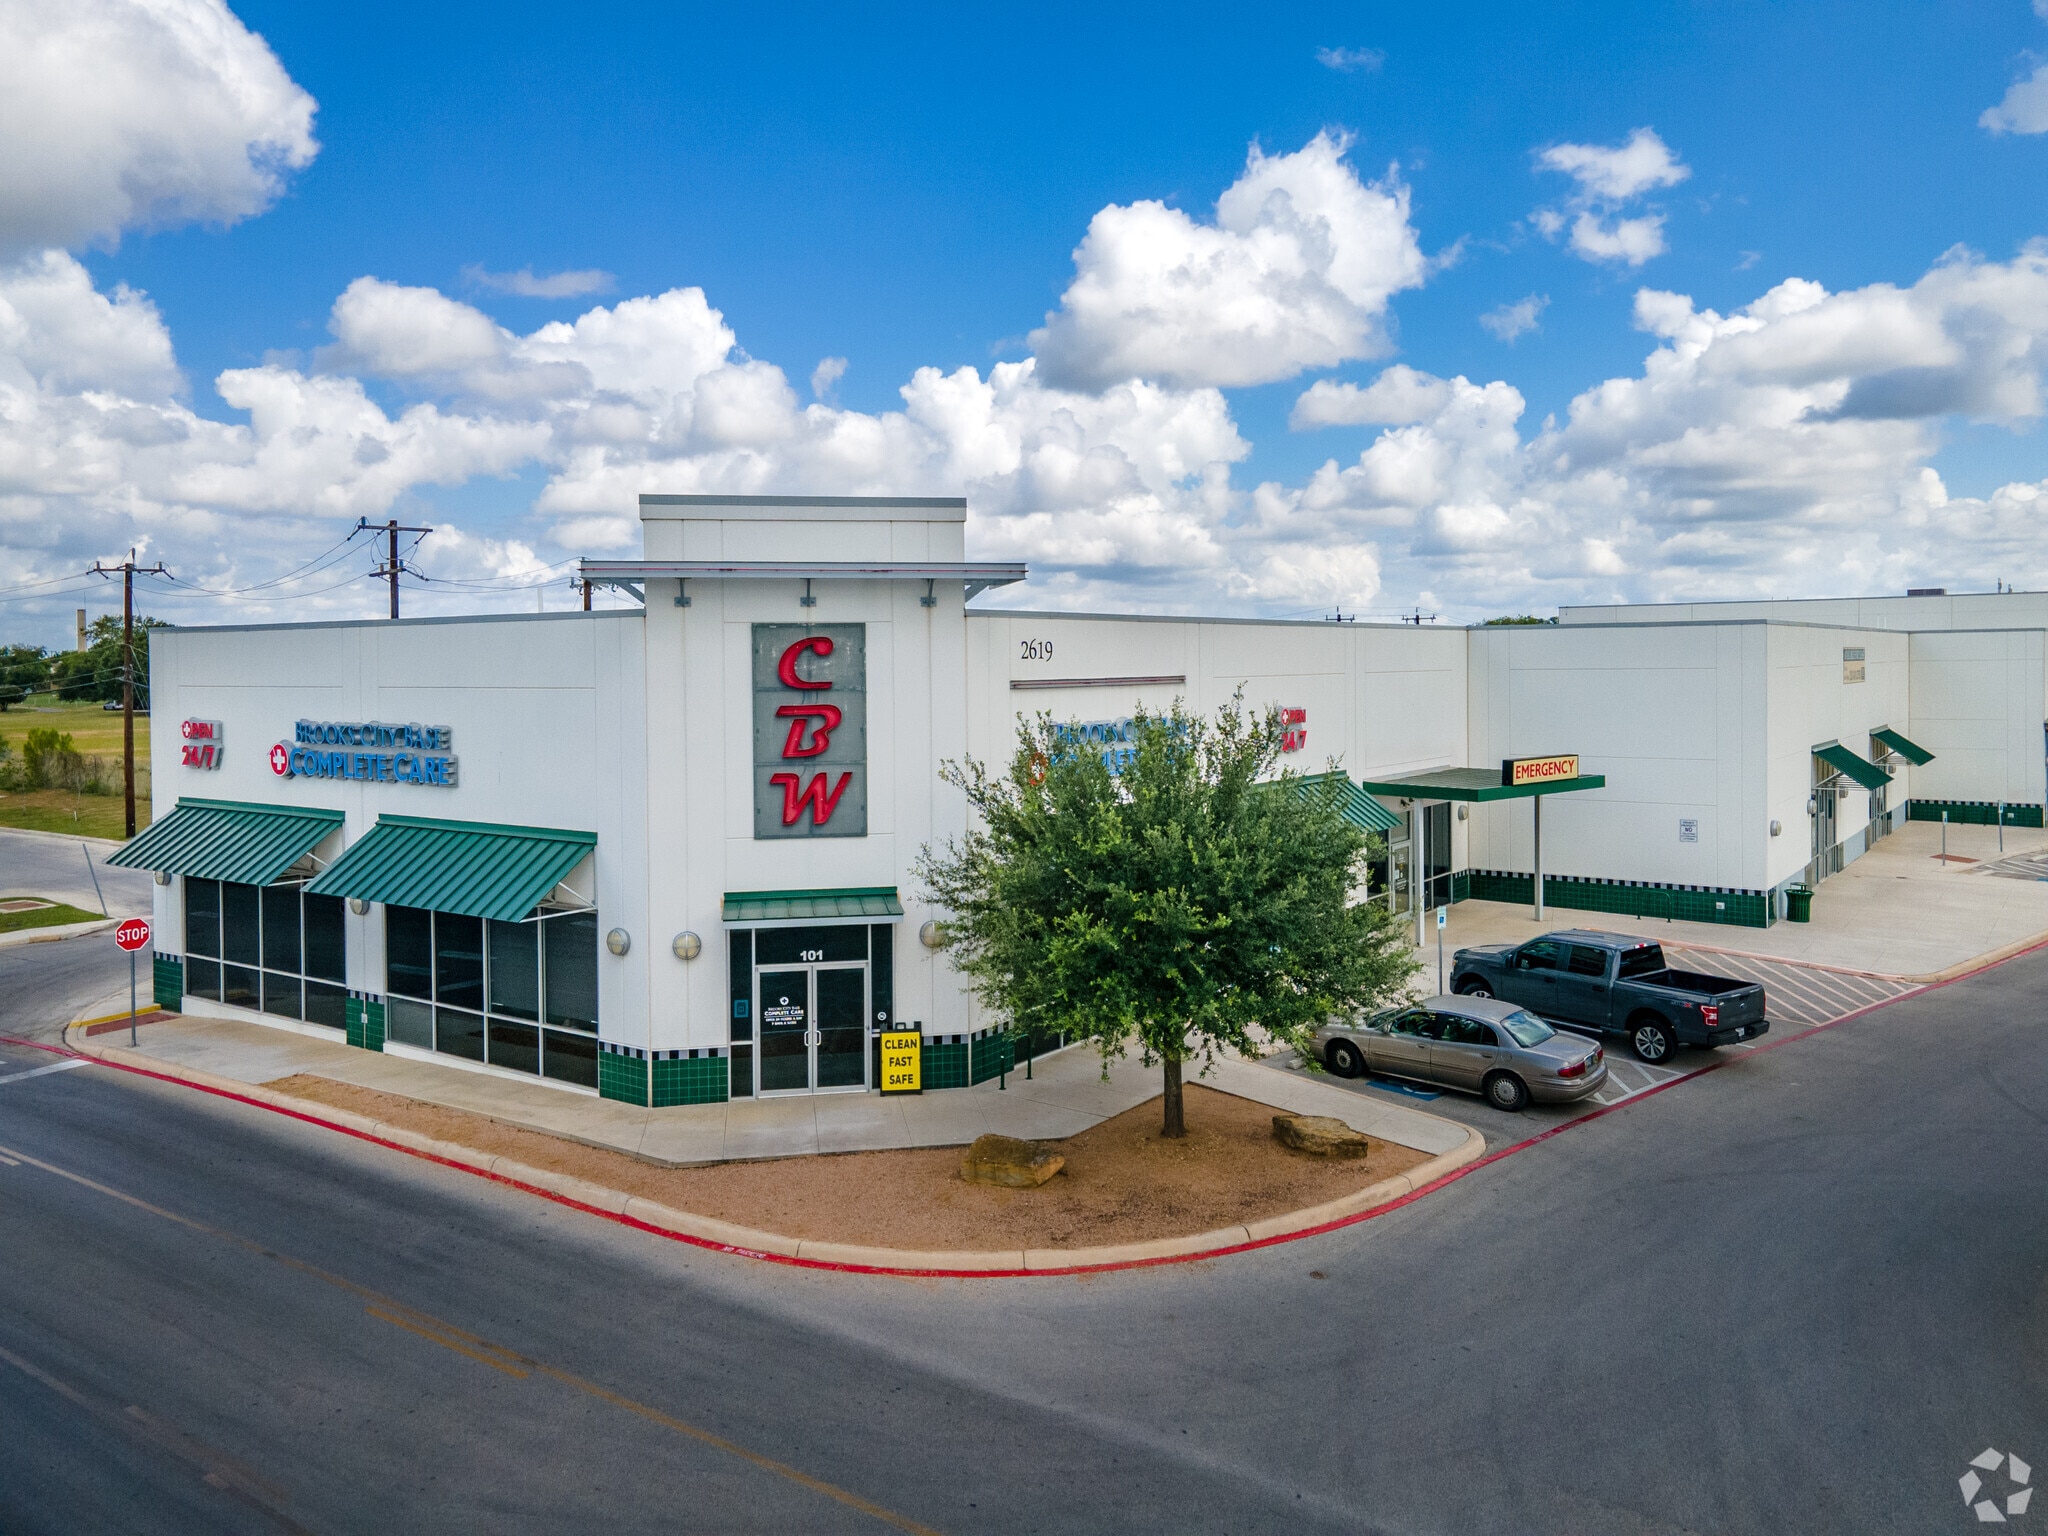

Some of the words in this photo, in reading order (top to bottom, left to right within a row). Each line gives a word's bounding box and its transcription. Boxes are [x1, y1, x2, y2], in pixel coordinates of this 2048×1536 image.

[1021, 638, 1053, 662] 2619
[181, 720, 213, 739] OPEN
[295, 721, 355, 746] BROOKS
[360, 723, 398, 747] CITY
[404, 725, 442, 750] BASE
[1281, 730, 1307, 751] 24/7
[181, 745, 214, 768] 24/7
[290, 747, 387, 780] COMPLETE
[394, 752, 449, 785] CARE
[1516, 760, 1575, 779] EMERGENCY
[117, 927, 148, 943] STOP
[800, 950, 823, 961] 101
[884, 1039, 917, 1050] CLEAN
[889, 1056, 912, 1067] FAST
[889, 1074, 914, 1085] SAFE
